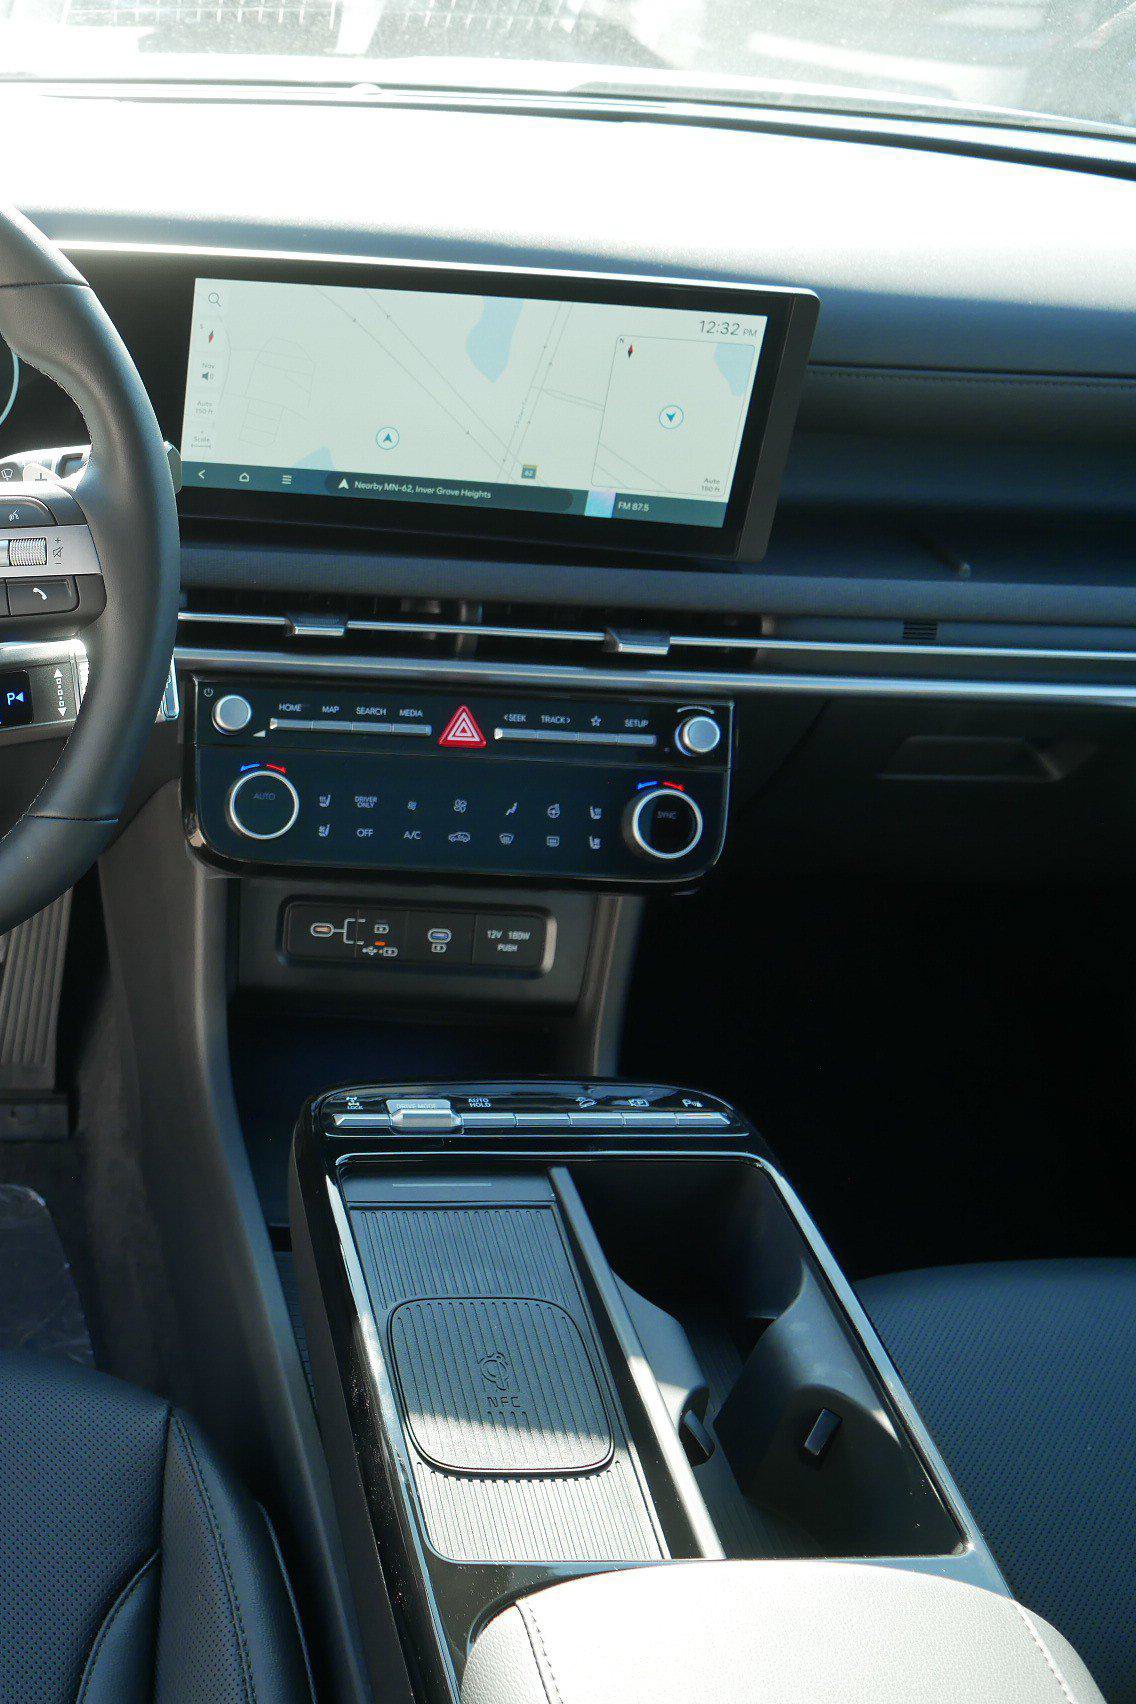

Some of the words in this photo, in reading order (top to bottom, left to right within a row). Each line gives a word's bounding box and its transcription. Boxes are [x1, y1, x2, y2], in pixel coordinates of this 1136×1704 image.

[699, 319, 741, 336] 12:32
[742, 328, 758, 337] PM
[354, 480, 383, 491] Nearby
[415, 485, 435, 494] Inver
[437, 487, 460, 497] Grove
[460, 489, 492, 499] Heights
[7, 692, 15, 706] P
[278, 703, 303, 713] HOME
[321, 705, 341, 714] MAP
[356, 707, 387, 716] SEARCH
[399, 709, 424, 718] MEDIA
[624, 718, 649, 728] SETUP
[253, 792, 276, 801] AUTO
[656, 810, 678, 820] SYNC
[356, 829, 374, 838] OFF
[403, 830, 422, 840] A/C
[487, 929, 502, 939] 12V
[487, 1396, 521, 1408] NFC
